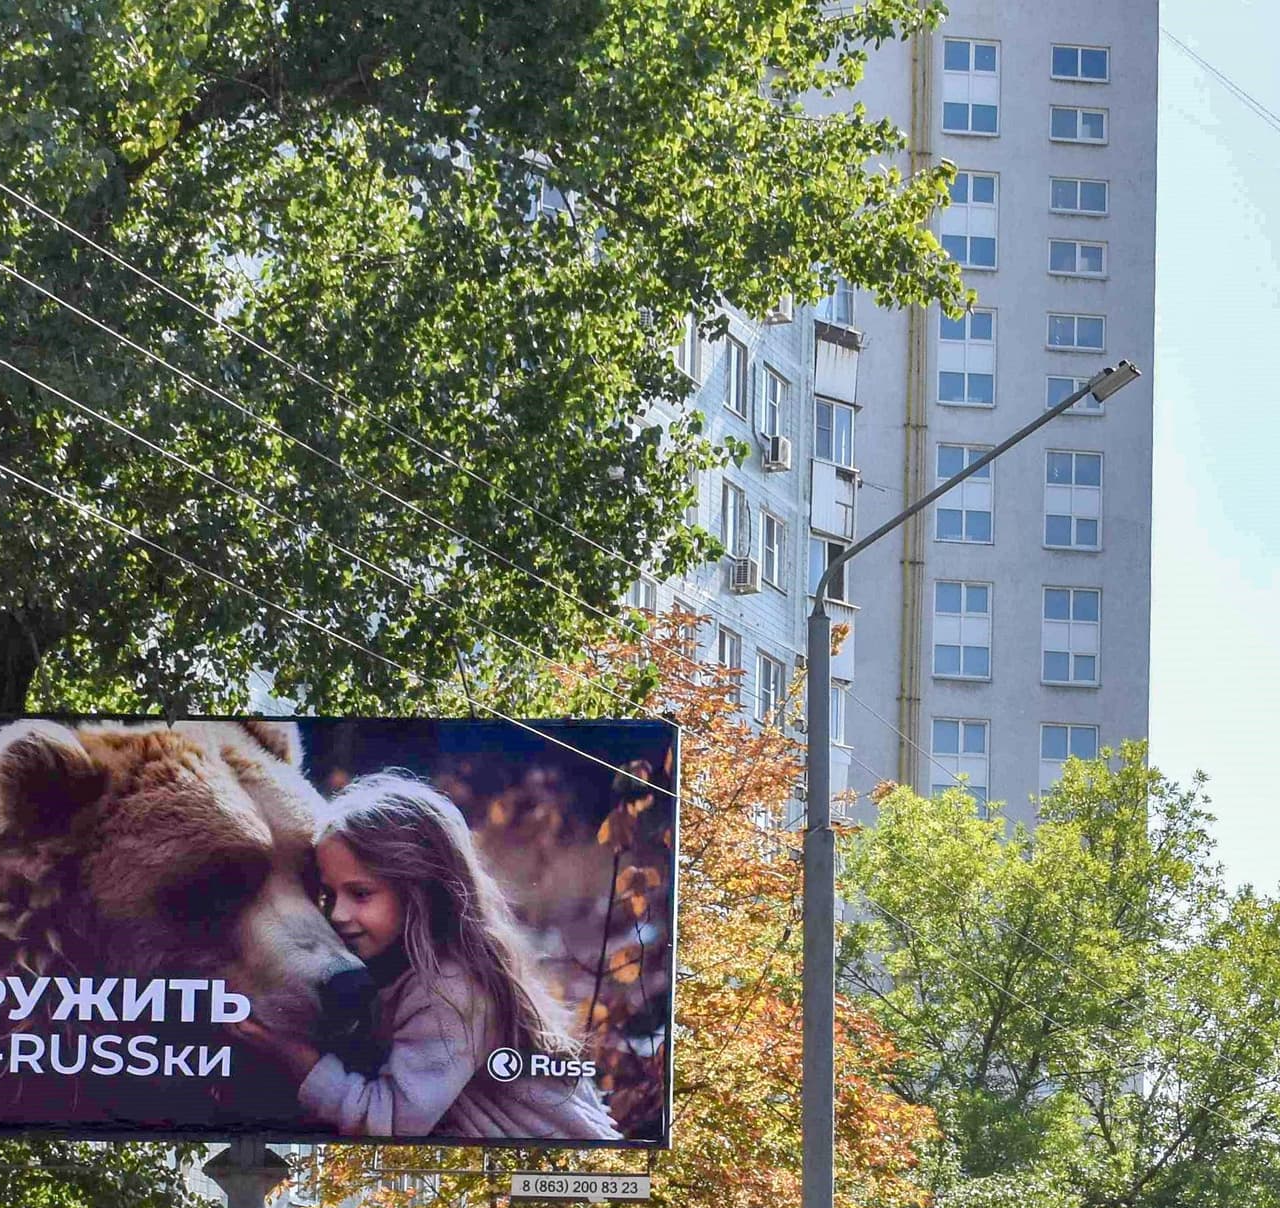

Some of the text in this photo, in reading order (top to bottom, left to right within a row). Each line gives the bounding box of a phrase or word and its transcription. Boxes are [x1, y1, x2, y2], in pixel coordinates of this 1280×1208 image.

[531, 1054, 597, 1077] Russ
[522, 1178, 638, 1194] 8 (863) 200 83 23
